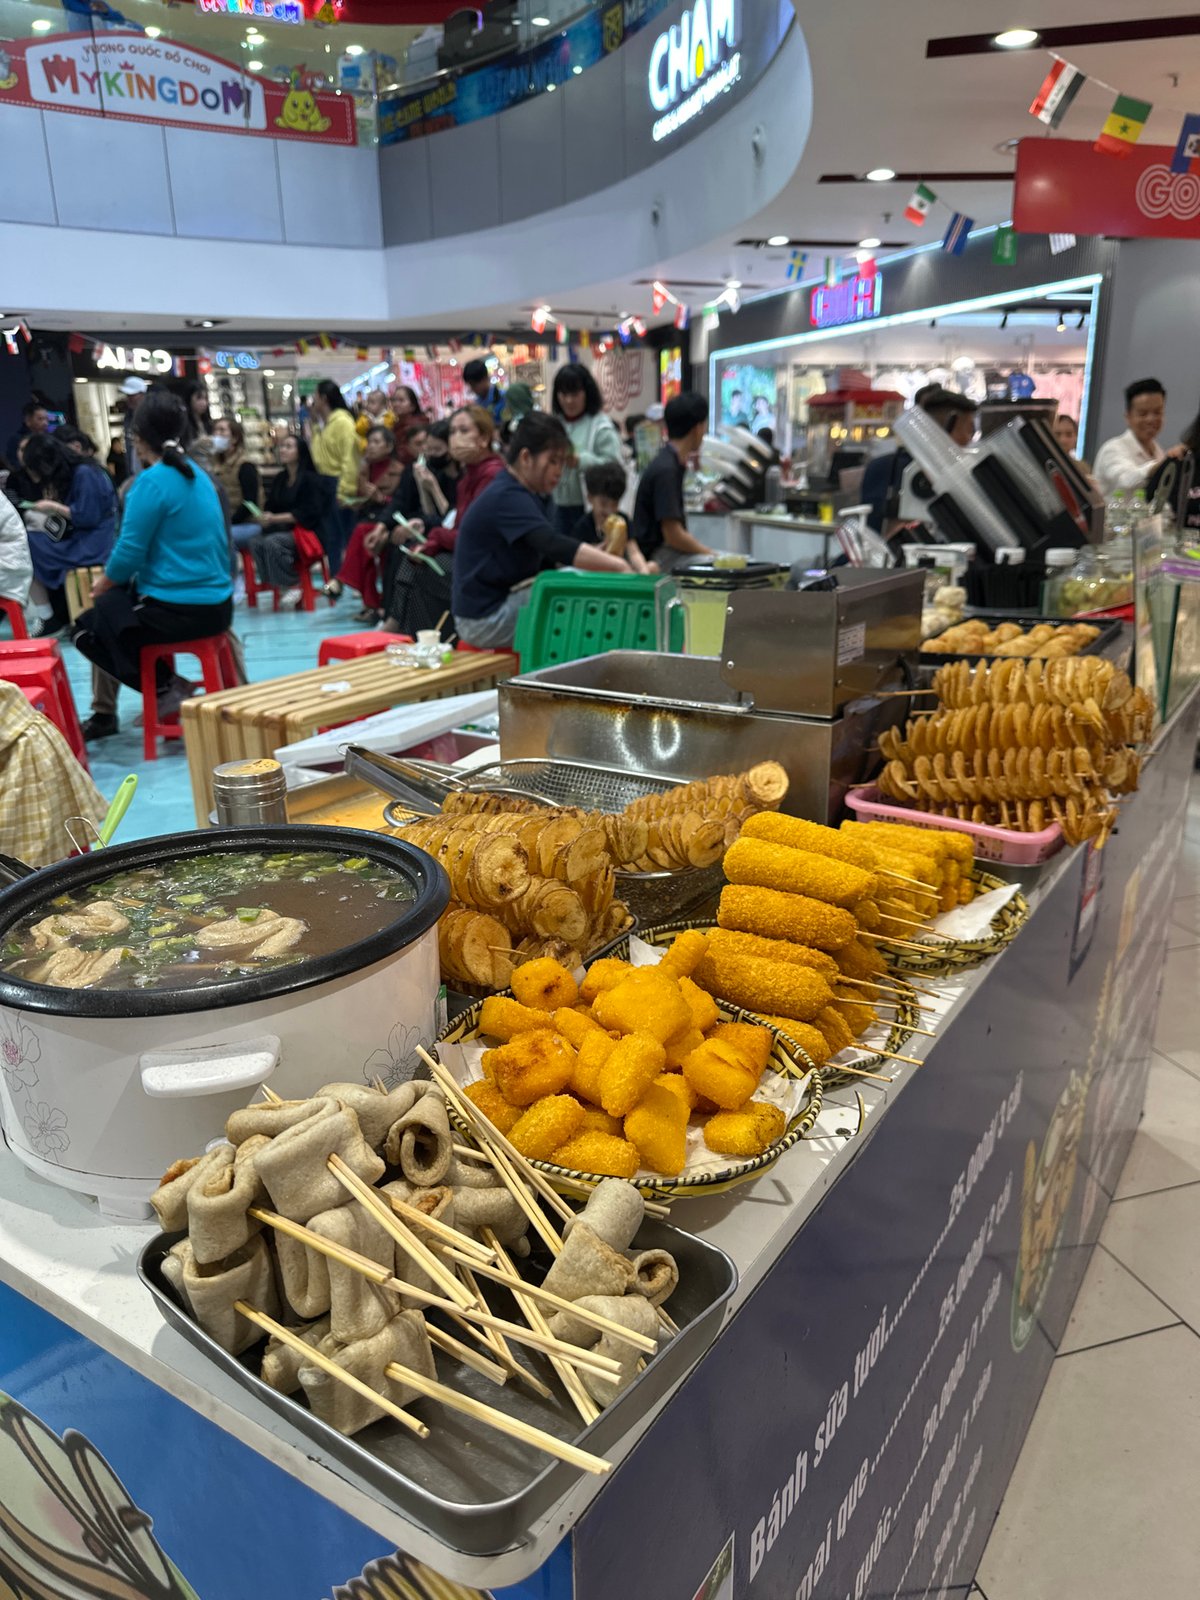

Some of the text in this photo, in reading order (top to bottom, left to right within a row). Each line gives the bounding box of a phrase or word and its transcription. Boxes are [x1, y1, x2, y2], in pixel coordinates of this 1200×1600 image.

[41, 54, 252, 121] MYKINGDOM
[749, 1449, 807, 1583] Bánh
[813, 1380, 849, 1468] sữa
[836, 1457, 869, 1541] que
